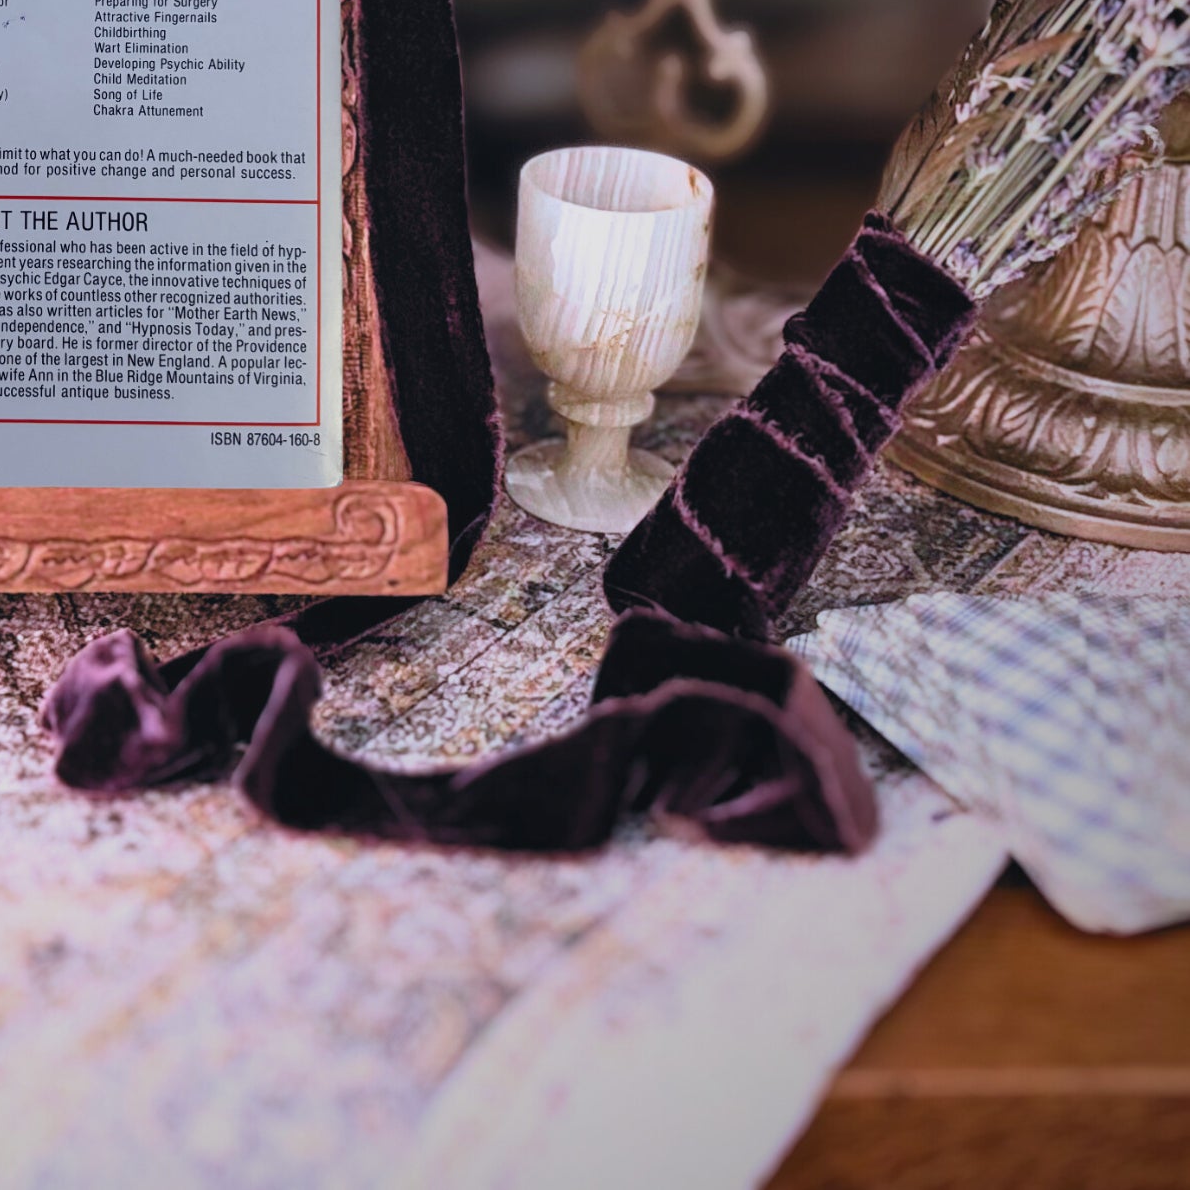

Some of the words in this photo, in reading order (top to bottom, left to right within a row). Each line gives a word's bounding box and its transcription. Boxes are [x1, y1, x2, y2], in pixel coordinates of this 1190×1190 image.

[94, 10, 150, 22] Attractive
[154, 10, 217, 26] Fingernails
[94, 26, 167, 41] Childbirthing
[94, 41, 121, 54] Wart
[125, 41, 189, 54] Elimination
[94, 57, 156, 73] Developing
[160, 58, 204, 73] Psychic
[207, 58, 245, 73] Ability
[93, 72, 122, 85] Child
[126, 73, 187, 85] Meditation
[93, 87, 122, 103] Song
[126, 88, 138, 100] of
[142, 88, 163, 101] Life
[93, 103, 134, 116] Chakra
[138, 104, 204, 117] Attunement
[23, 163, 42, 175] for
[46, 163, 96, 179] positive
[101, 164, 147, 180] change
[151, 165, 175, 177] and
[180, 165, 236, 181] personal
[240, 169, 296, 179] success.
[20, 211, 59, 231] THE
[65, 212, 148, 232] AUTHOR
[24, 353, 38, 366] of
[40, 353, 61, 366] the
[64, 354, 109, 369] largest
[112, 354, 124, 367] in
[127, 354, 155, 367] New
[158, 355, 214, 370] England.
[217, 355, 228, 368] A
[231, 356, 281, 371] popular
[284, 357, 307, 369] lec-
[210, 433, 242, 446] ISBN
[246, 434, 321, 446] 87604-160-8
